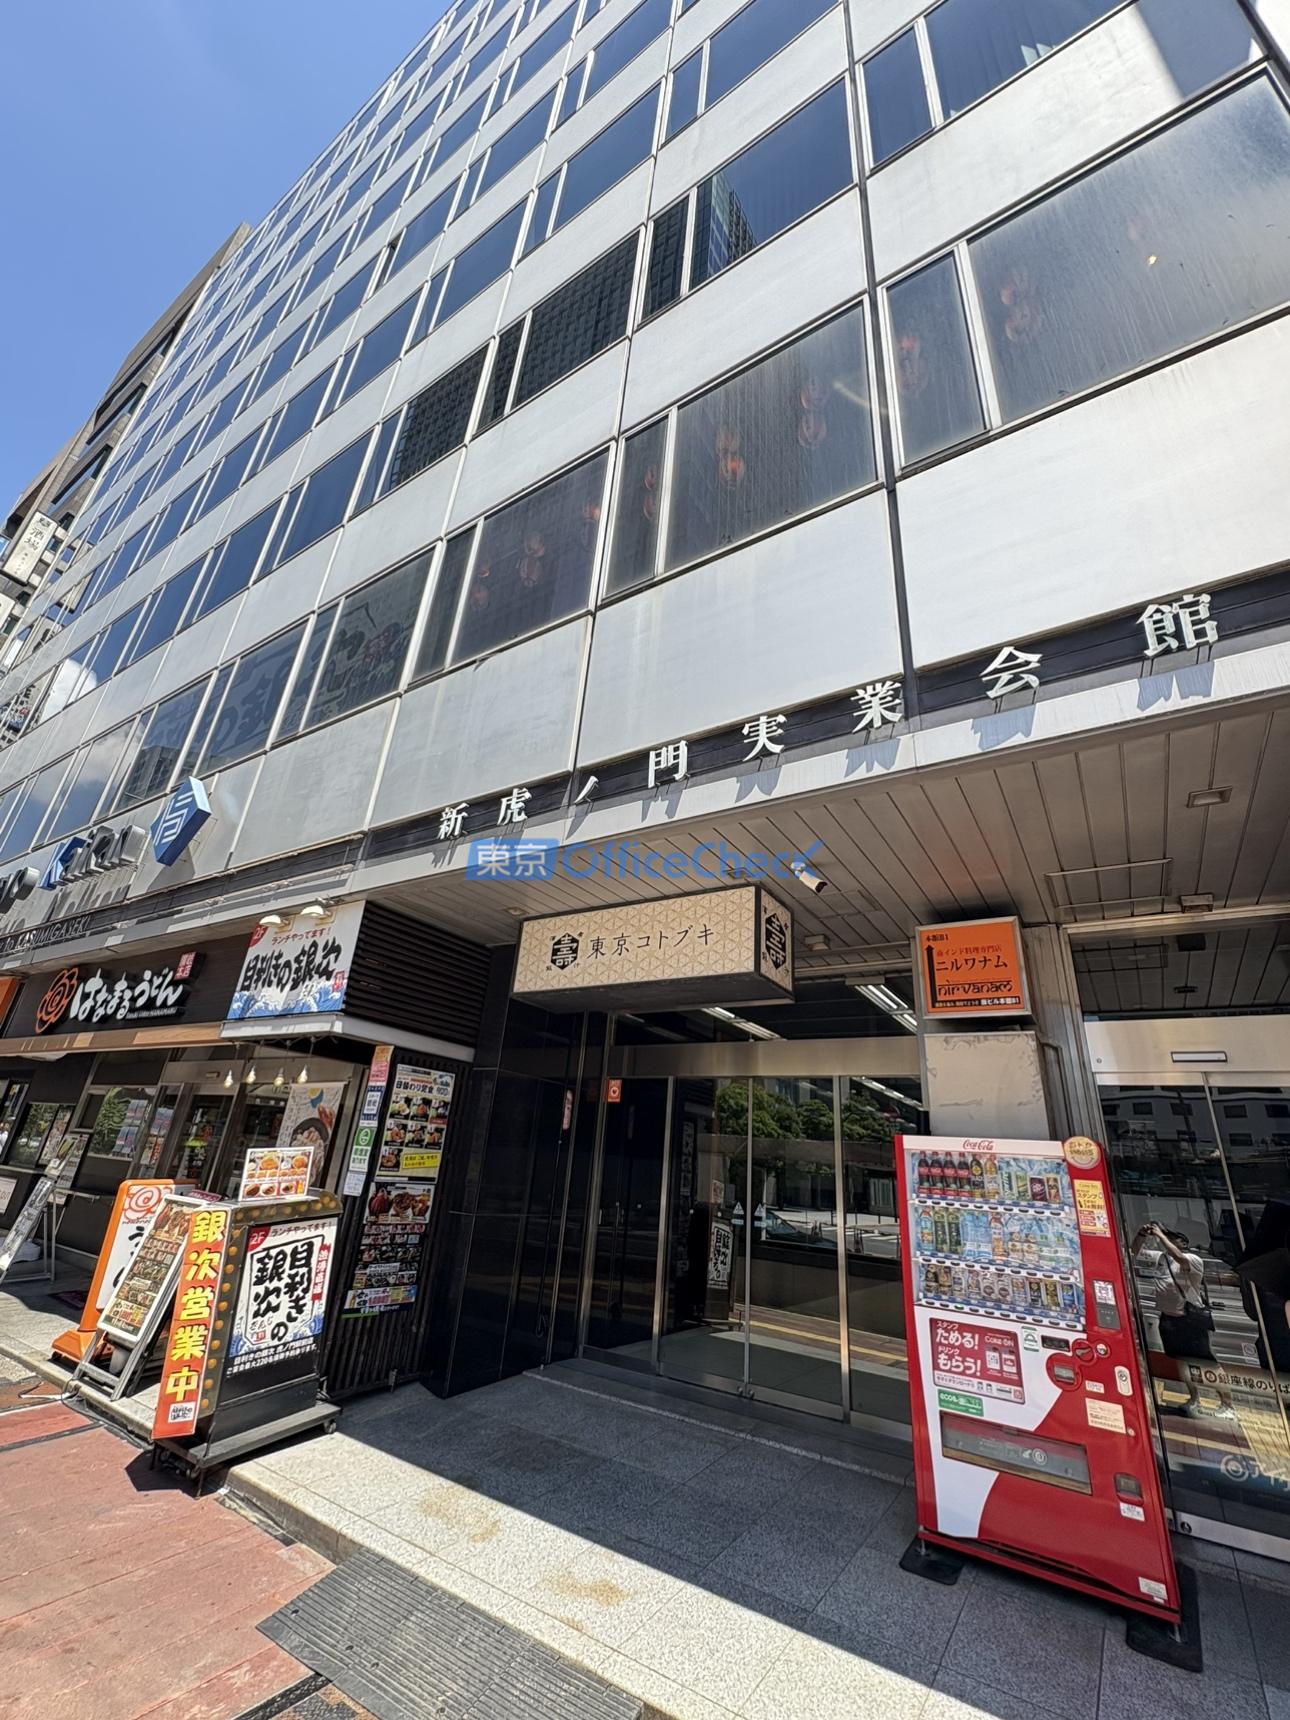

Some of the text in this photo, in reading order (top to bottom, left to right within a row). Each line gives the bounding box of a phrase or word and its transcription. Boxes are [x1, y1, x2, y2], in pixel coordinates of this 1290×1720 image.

[437, 593, 1219, 841] 新虎ノ門実業会館
[15, 916, 92, 950] KASUMIGASEKI
[586, 923, 715, 960] 東京コトブキ
[240, 936, 343, 993] 目利きの銀次
[936, 955, 1008, 972] ニルワナム
[69, 967, 184, 1024] はなまるうどん
[937, 978, 1013, 997] nirvanam
[250, 1231, 266, 1245] 2F
[271, 1221, 332, 1237] ランチやってます！
[252, 1249, 288, 1319] 銀次
[271, 1240, 315, 1341] 目利きの
[165, 1211, 227, 1402] 銀次営業中
[936, 1327, 980, 1350] ためる！
[937, 1320, 960, 1330] スタンプ
[937, 1353, 981, 1377] もらう！
[938, 1346, 960, 1355] ドリンク
